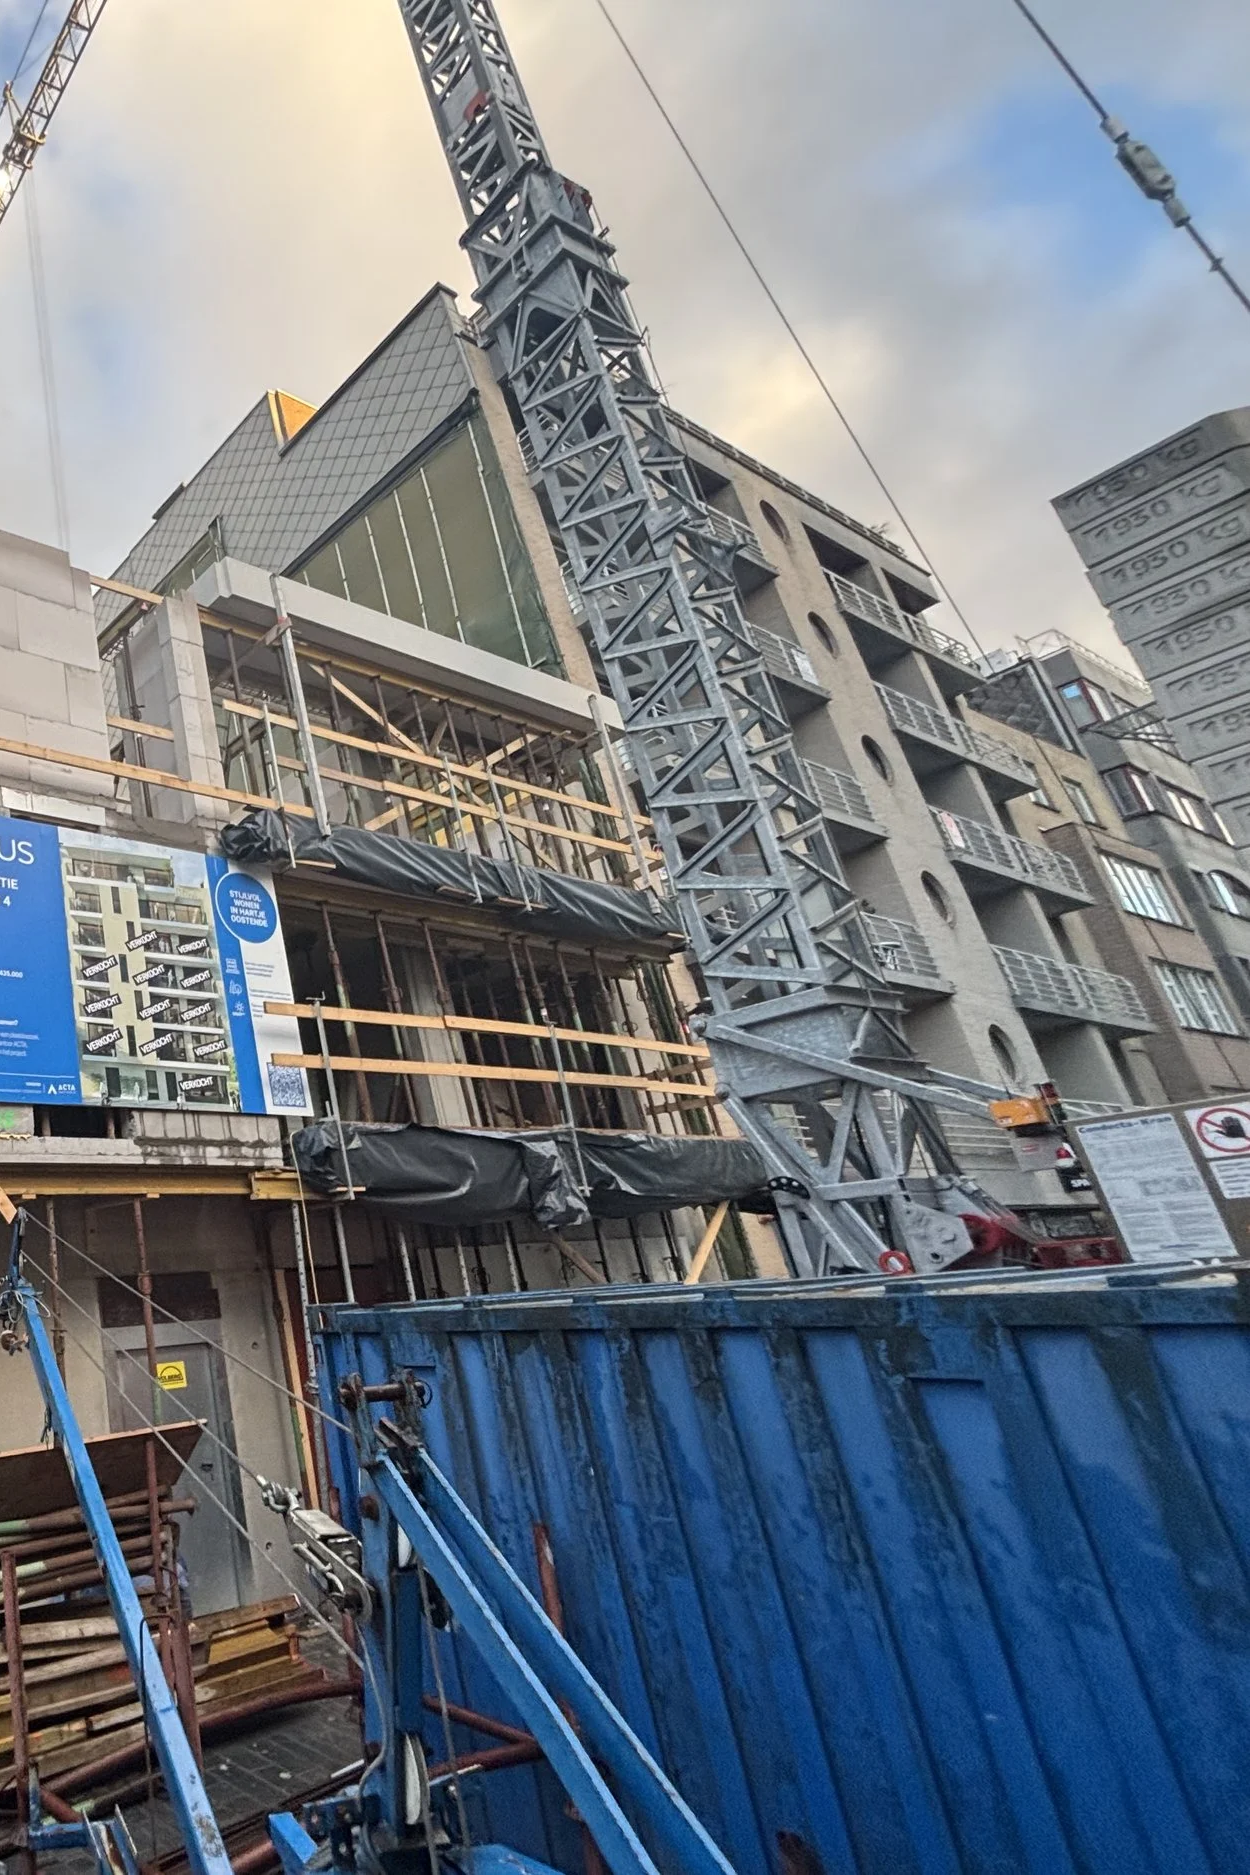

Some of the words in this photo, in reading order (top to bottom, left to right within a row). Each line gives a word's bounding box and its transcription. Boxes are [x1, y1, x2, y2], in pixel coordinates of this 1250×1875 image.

[1094, 499, 1171, 542] 1930
[1113, 540, 1189, 582] 1930
[3, 896, 11, 907] 4
[229, 890, 262, 902] STIJLVOL
[234, 899, 260, 910] WONEN
[230, 906, 238, 914] IN
[239, 908, 266, 919] HARTJE
[231, 915, 268, 928] OOSTENDE
[127, 931, 157, 951] VERKOCHT
[178, 939, 208, 954] VERKOCHT
[83, 957, 116, 977] VERKOCHT
[134, 964, 165, 984] VERKOCHT
[181, 970, 211, 988] VERKOCHT
[85, 994, 120, 1014] VERKOCHT
[139, 999, 171, 1019] VERKOCHT
[181, 1002, 211, 1021] VERKOCHT
[86, 1029, 121, 1052] VERKOCHT
[141, 1033, 173, 1055] VERKOCHT
[194, 1040, 226, 1056] VERKOCHT
[58, 1083, 76, 1091] ACTA
[180, 1077, 213, 1091] VERKOCHT
